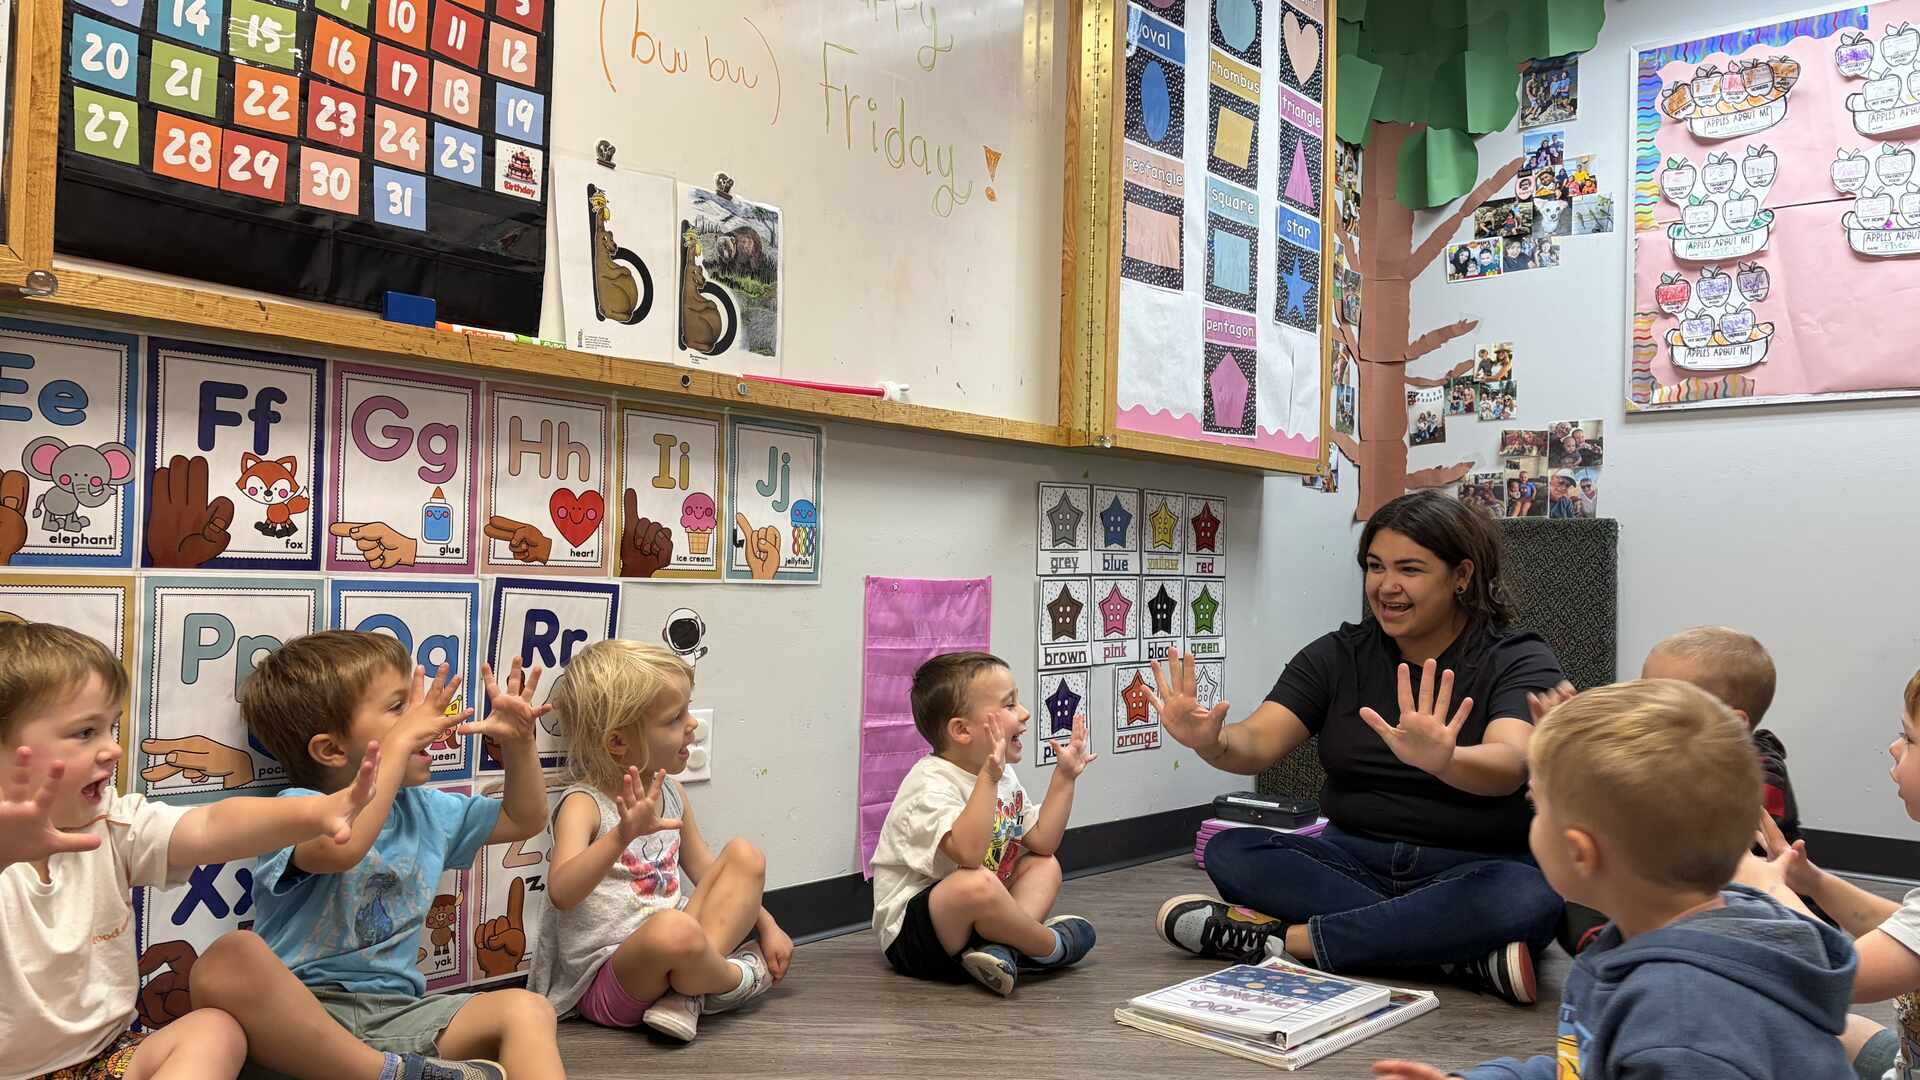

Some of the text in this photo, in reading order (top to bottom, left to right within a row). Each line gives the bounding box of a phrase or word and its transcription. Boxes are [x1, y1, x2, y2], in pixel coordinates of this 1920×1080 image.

[173, 0, 211, 36] 14
[388, 0, 416, 33] 10
[447, 16, 467, 50] 11
[247, 15, 283, 53] 15
[1142, 23, 1171, 50] oval
[80, 33, 130, 79] 20
[327, 36, 357, 75] 16
[502, 38, 528, 72] 12
[164, 59, 202, 101] 21
[391, 60, 418, 96] 17
[1210, 57, 1261, 95] rhombus
[243, 80, 291, 121] 22
[444, 79, 469, 114] 18
[1281, 94, 1322, 129] triangle
[1899, 106, 1920, 118] ABOU
[84, 103, 129, 149] 27
[315, 96, 357, 137] 23
[507, 99, 535, 133] 19
[162, 128, 212, 172] 28
[380, 120, 420, 160] 24
[440, 136, 476, 174] 25
[228, 144, 279, 190] 29
[309, 161, 351, 201] 30
[1125, 156, 1184, 187] rectangle
[386, 182, 413, 217] 31
[503, 180, 536, 198] Birthday
[1211, 187, 1255, 215] square
[1285, 216, 1312, 241] star
[1206, 317, 1255, 339] pentagon
[197, 380, 288, 455] Ff
[351, 395, 459, 484] Gg
[508, 415, 591, 482] Hh
[652, 433, 690, 491] Ii
[756, 446, 791, 512] Jj
[49, 533, 115, 547] elephant
[285, 538, 304, 549] fox
[439, 545, 461, 557] glue
[569, 548, 595, 559] heart
[676, 555, 712, 564] ice cream
[784, 557, 810, 568] jellyfish
[1049, 556, 1080, 573] grey
[1102, 553, 1129, 571] blue
[1196, 558, 1215, 574] red
[521, 608, 588, 669] Rr
[1103, 642, 1128, 662] pink
[1148, 640, 1177, 659] blac
[1190, 641, 1220, 656] green
[1044, 646, 1088, 666] brown
[431, 752, 457, 761] ueen
[1116, 731, 1159, 749] orange
[434, 955, 453, 970] yak
